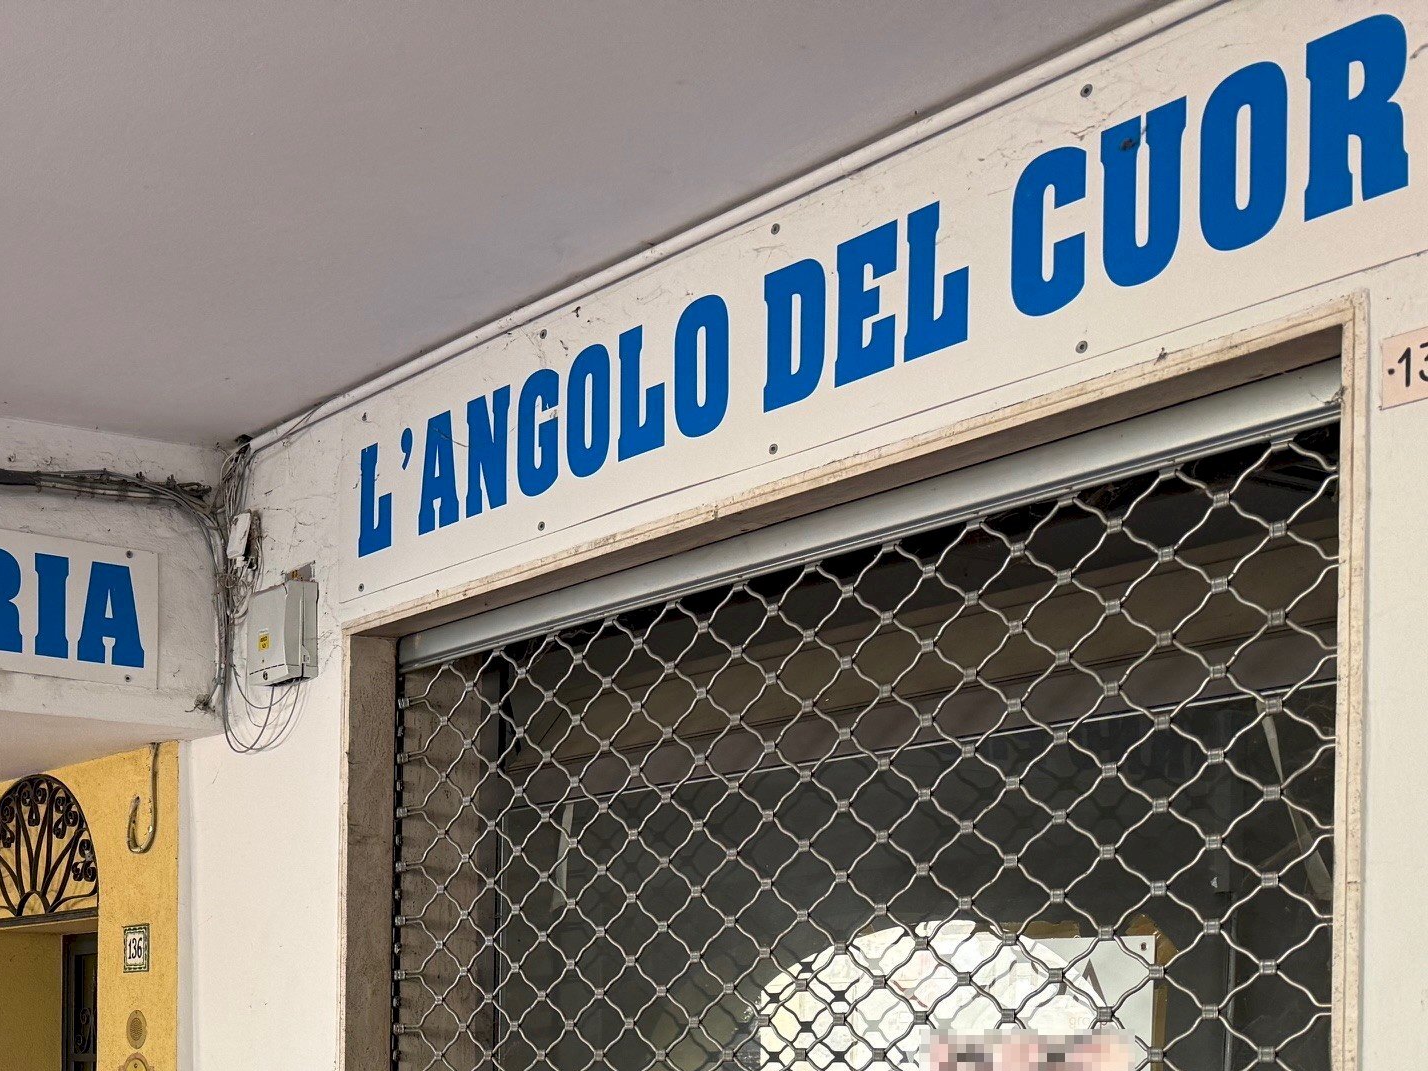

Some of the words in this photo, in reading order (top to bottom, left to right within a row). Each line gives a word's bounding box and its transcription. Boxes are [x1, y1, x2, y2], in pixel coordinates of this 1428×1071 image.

[358, 294, 730, 557] L'ANGOLO
[763, 201, 970, 413] DEL
[1010, 14, 1409, 318] CUOR
[128, 937, 143, 960] 136
